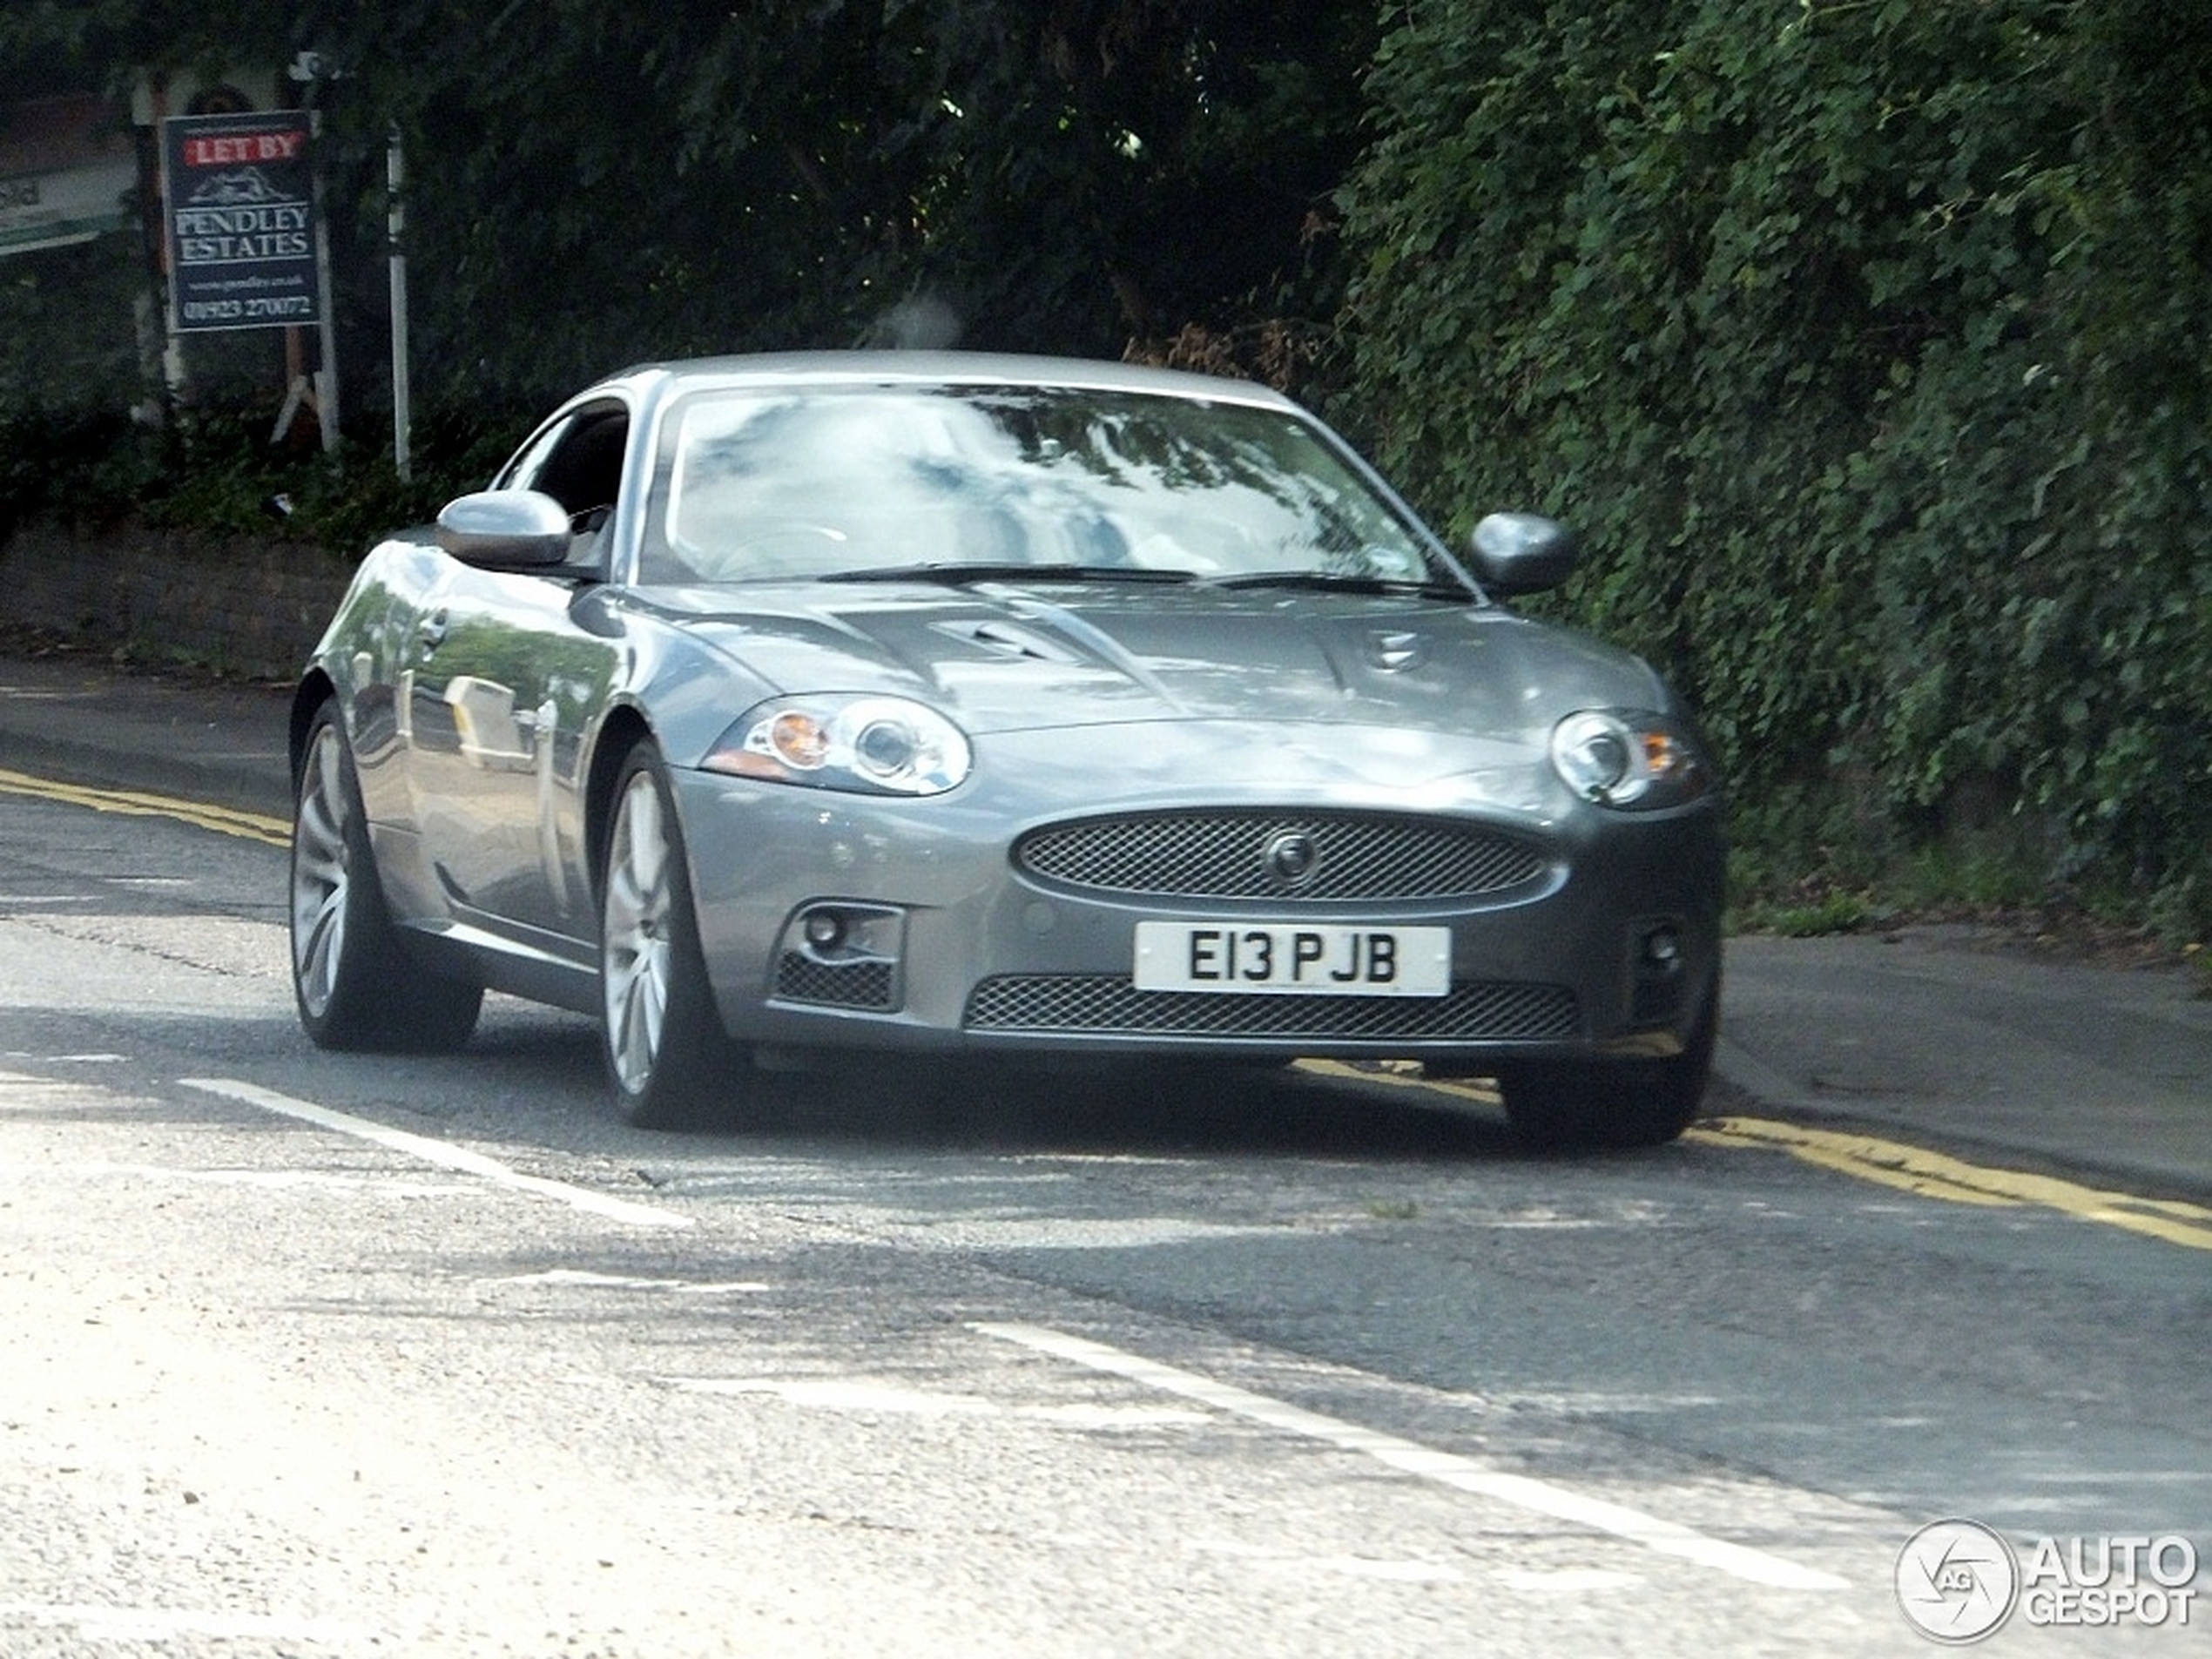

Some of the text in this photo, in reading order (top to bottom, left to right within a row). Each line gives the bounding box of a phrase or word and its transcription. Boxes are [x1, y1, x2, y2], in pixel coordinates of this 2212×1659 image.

[196, 133, 299, 164] LET BY
[176, 207, 308, 235] PENDLEY
[181, 233, 308, 260] ESTATES
[1189, 930, 1397, 982] E13 PJB
